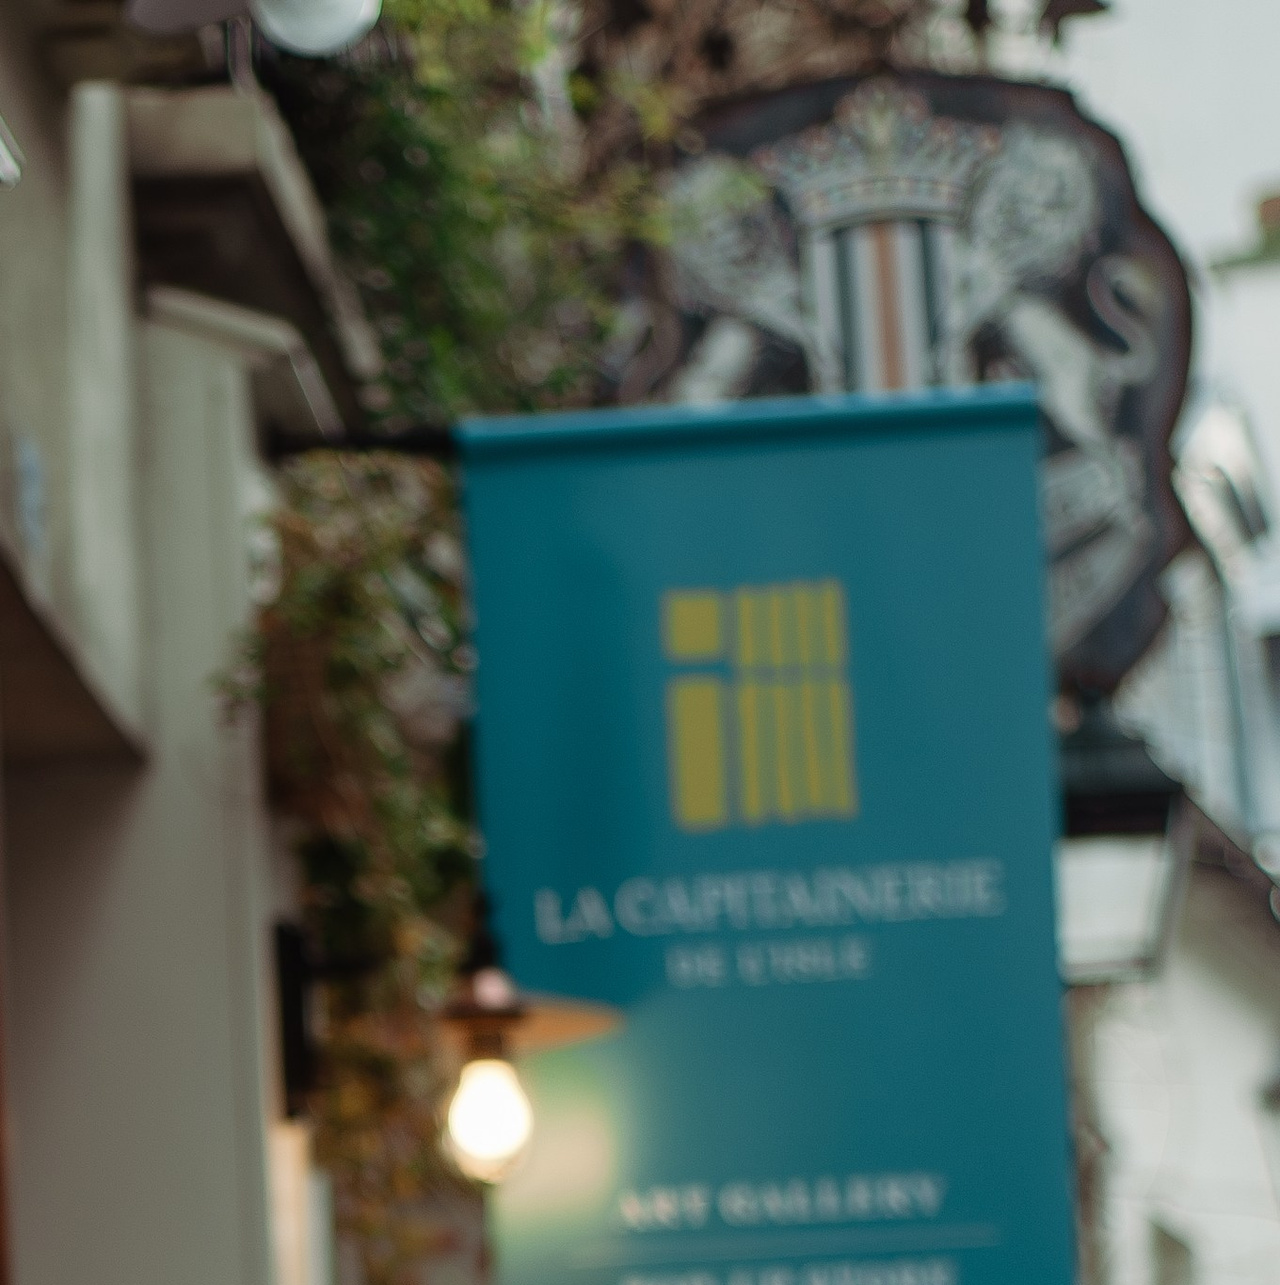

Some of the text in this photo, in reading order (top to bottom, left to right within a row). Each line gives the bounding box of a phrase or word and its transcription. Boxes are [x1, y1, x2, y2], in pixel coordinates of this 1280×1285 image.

[534, 858, 1002, 945] LA CAPITAINERIE
[667, 942, 725, 986] DE
[620, 1174, 946, 1232] ART GALLERY
